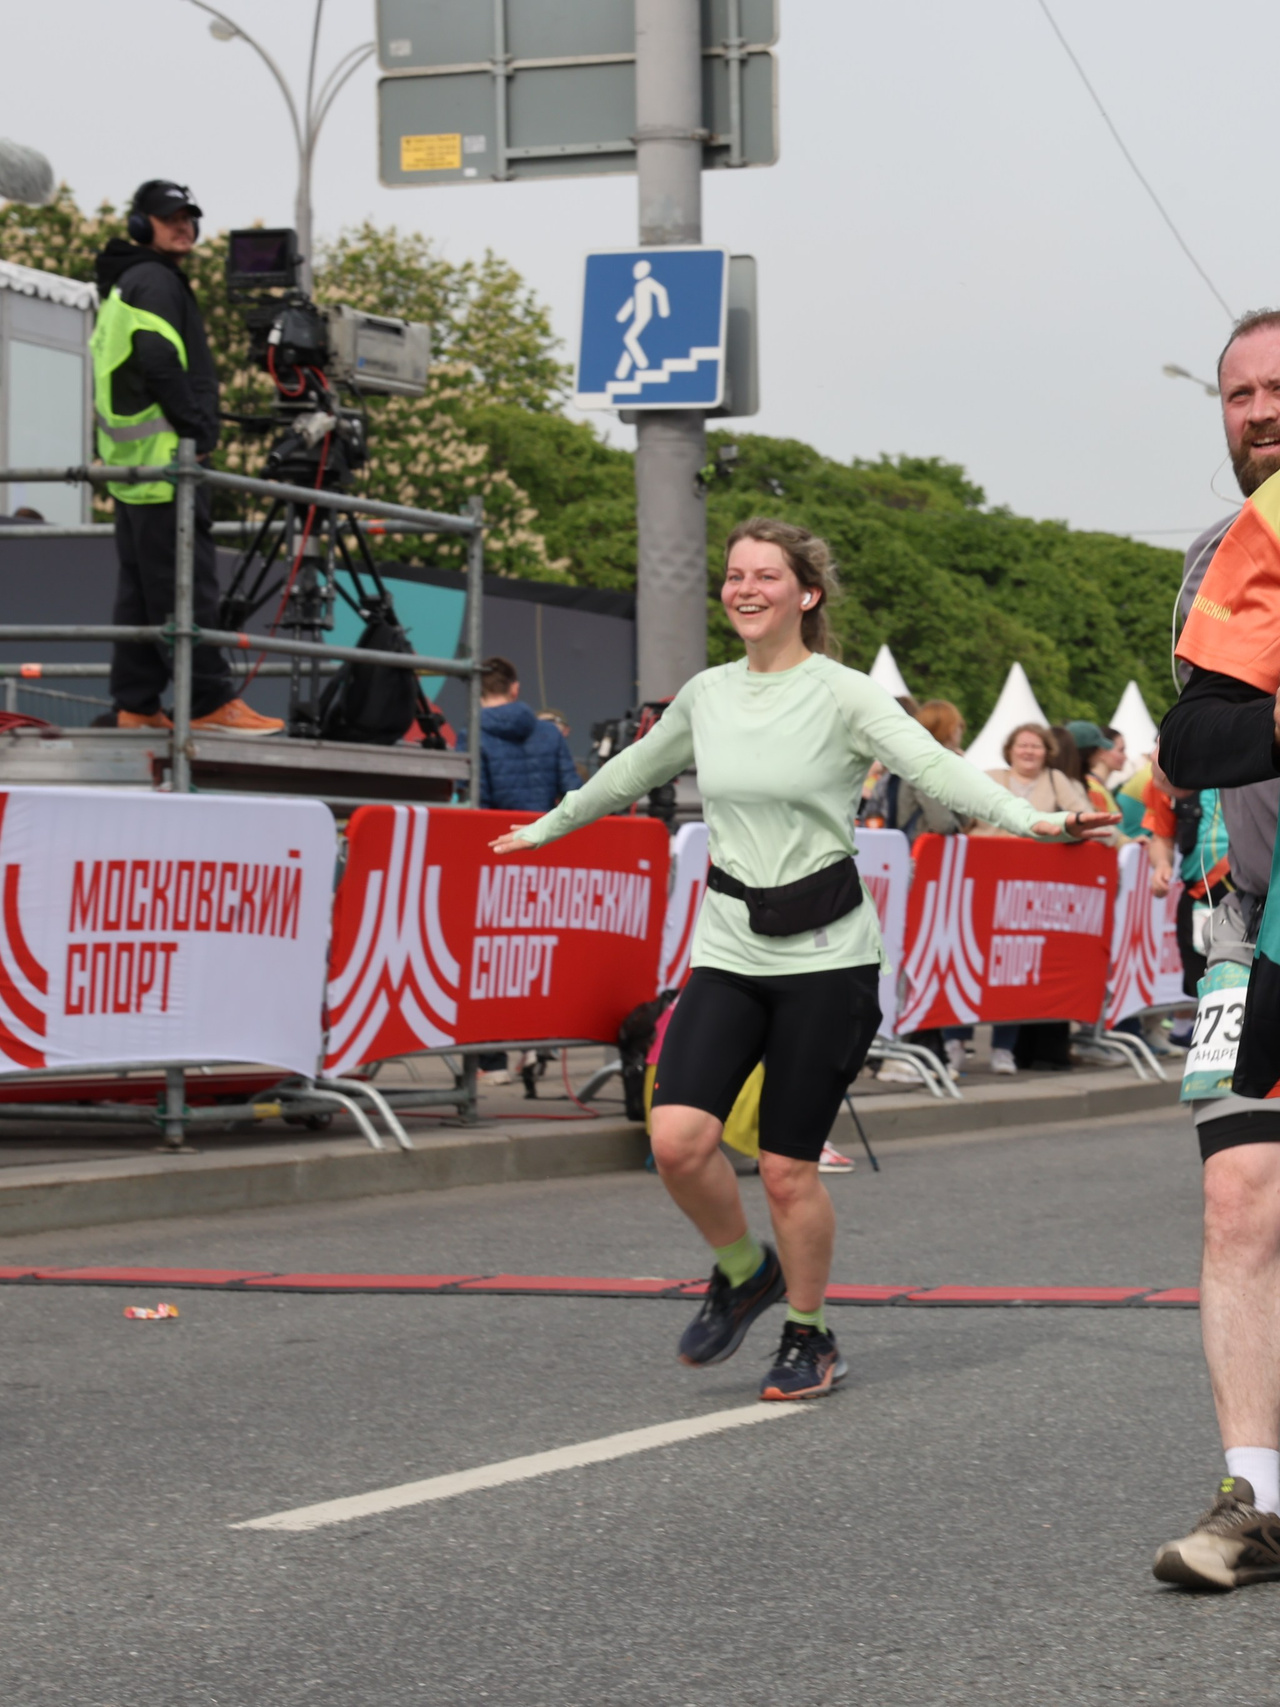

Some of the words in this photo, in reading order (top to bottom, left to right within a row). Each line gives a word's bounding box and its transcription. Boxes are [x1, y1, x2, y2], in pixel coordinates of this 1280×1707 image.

[69, 849, 303, 940] МОСКОВСКИЙ
[475, 859, 652, 941] МОСКОВСКИЙ
[993, 876, 1107, 938] МОСКОВСКИЙ
[64, 942, 178, 1015] СПОРТ
[469, 935, 559, 1000] СПОРТ
[988, 935, 1046, 986] СПОРТ
